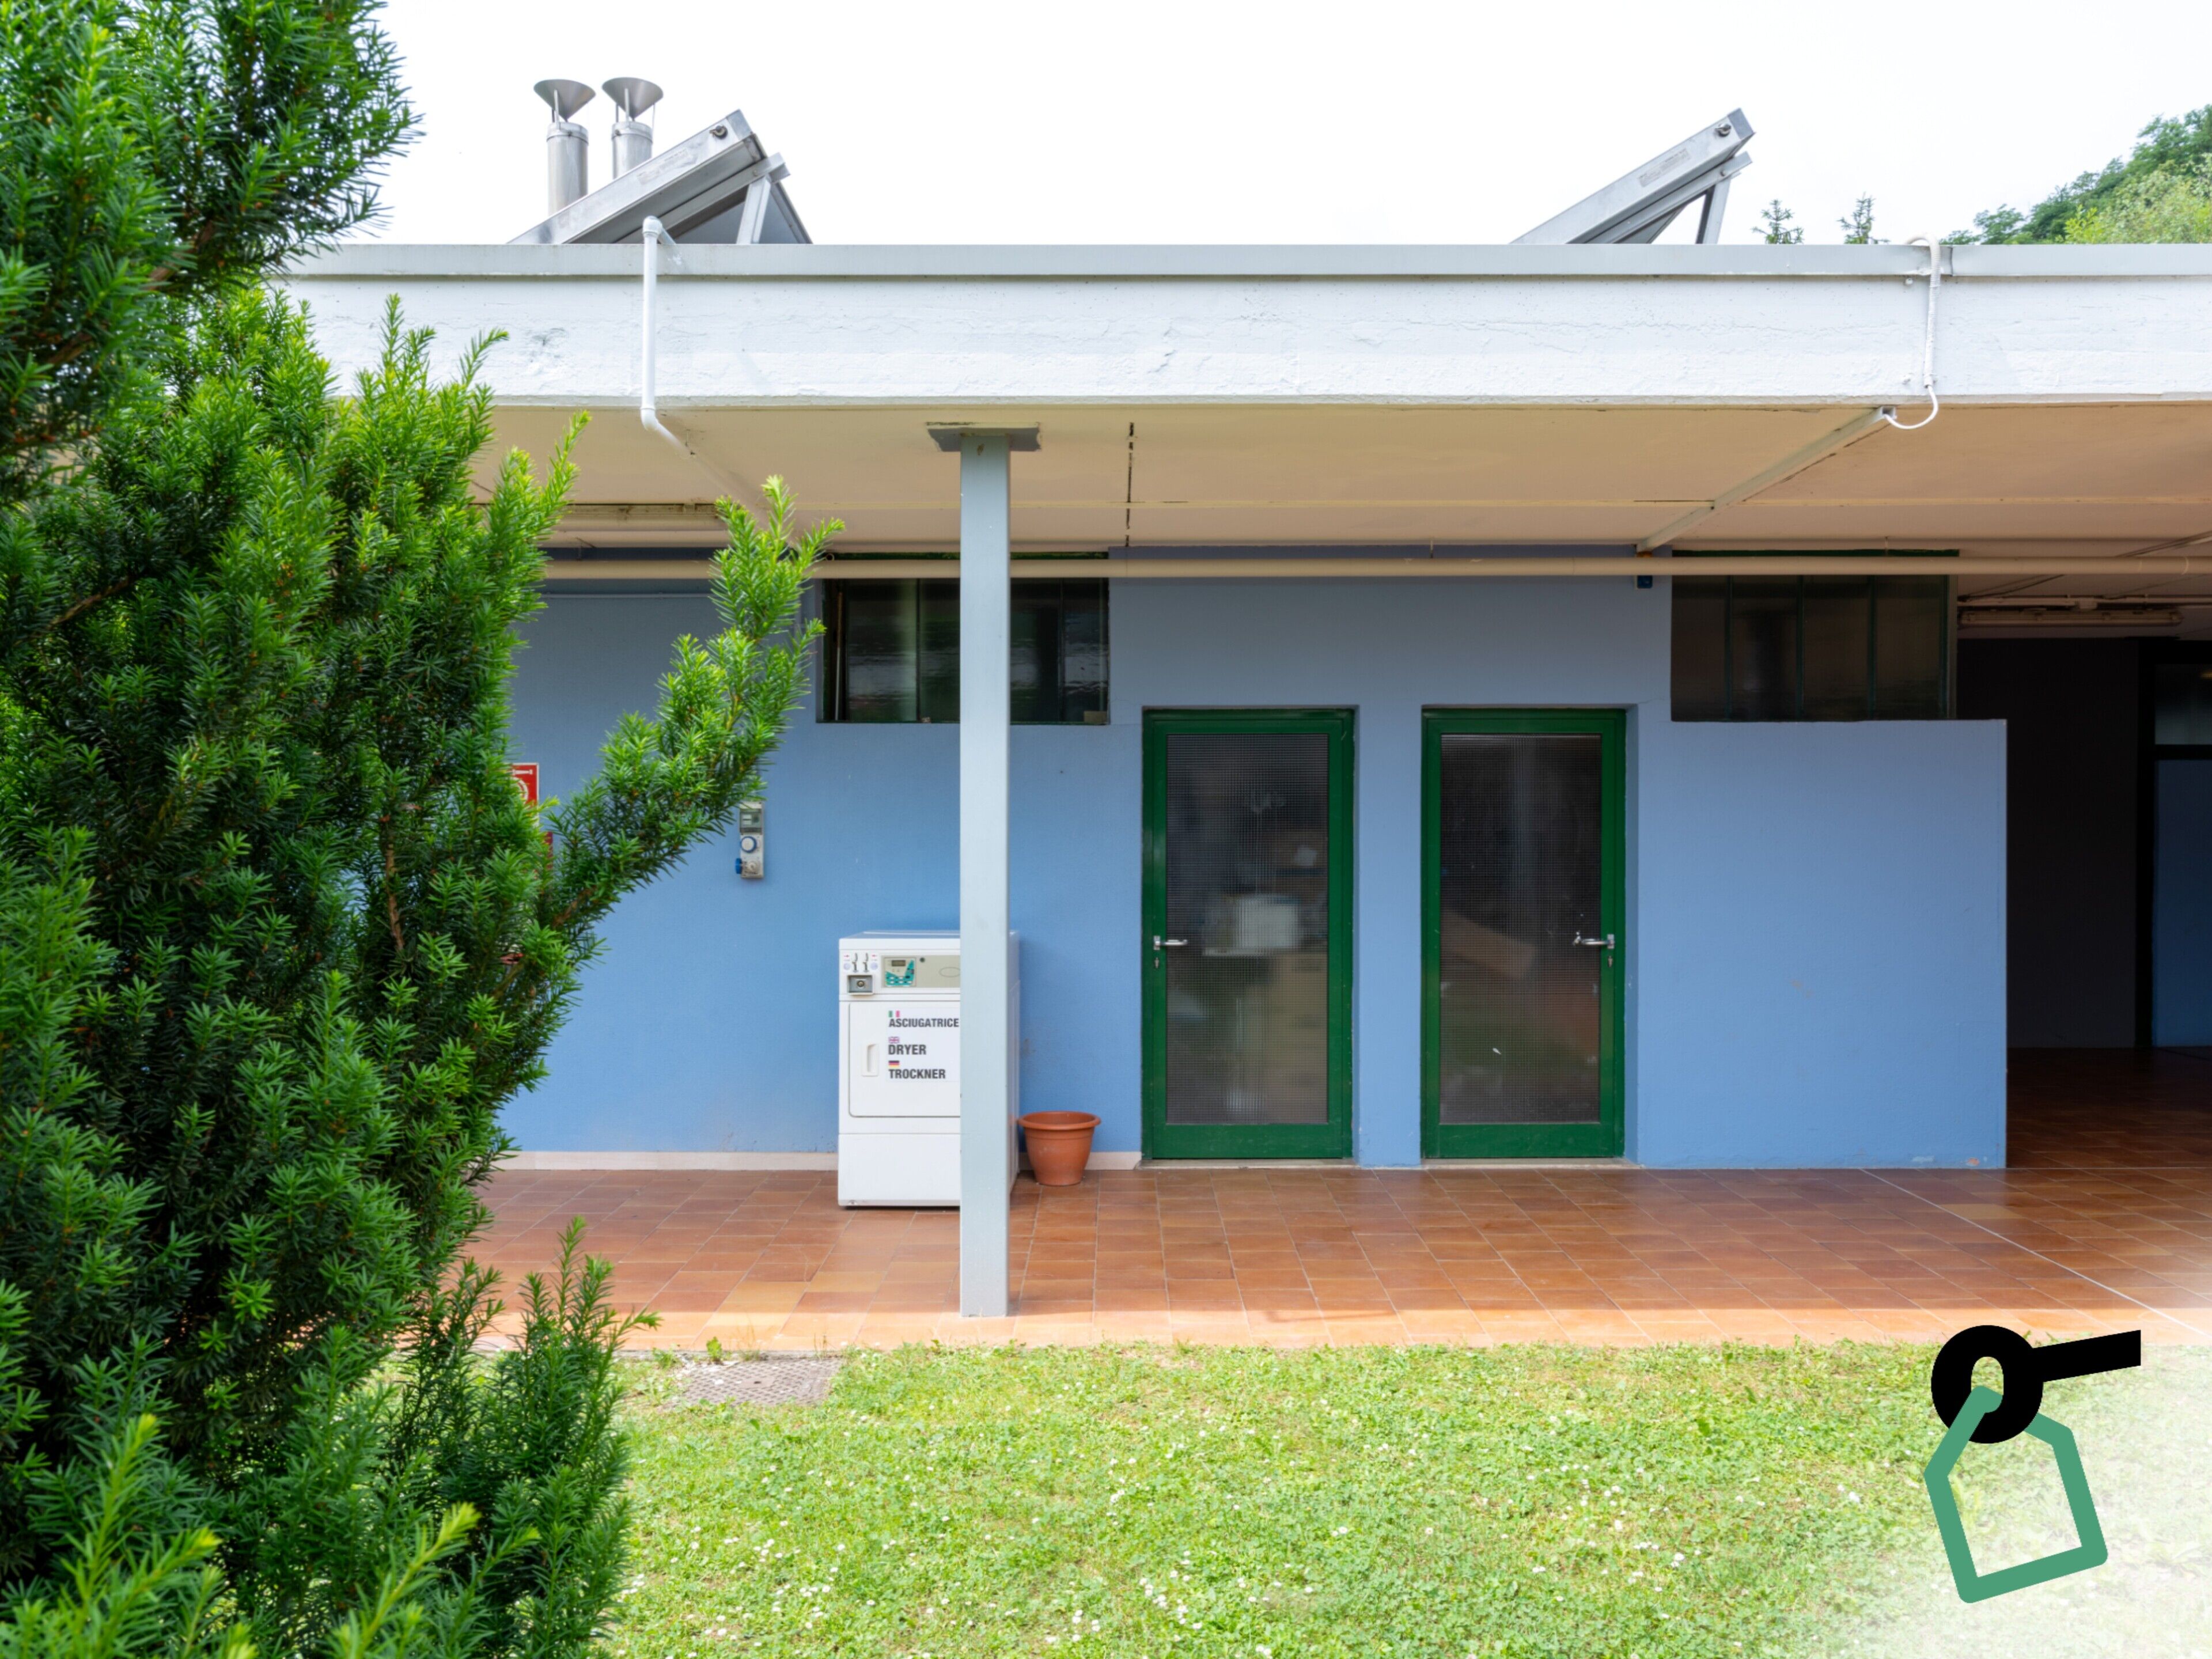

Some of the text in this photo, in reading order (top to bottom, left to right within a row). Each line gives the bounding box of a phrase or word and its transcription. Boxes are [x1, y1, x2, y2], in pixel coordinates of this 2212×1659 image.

[888, 1018, 959, 1028] ASCIUGATRICE
[888, 1044, 926, 1055] DRYER
[888, 1069, 946, 1079] TROCKNER
